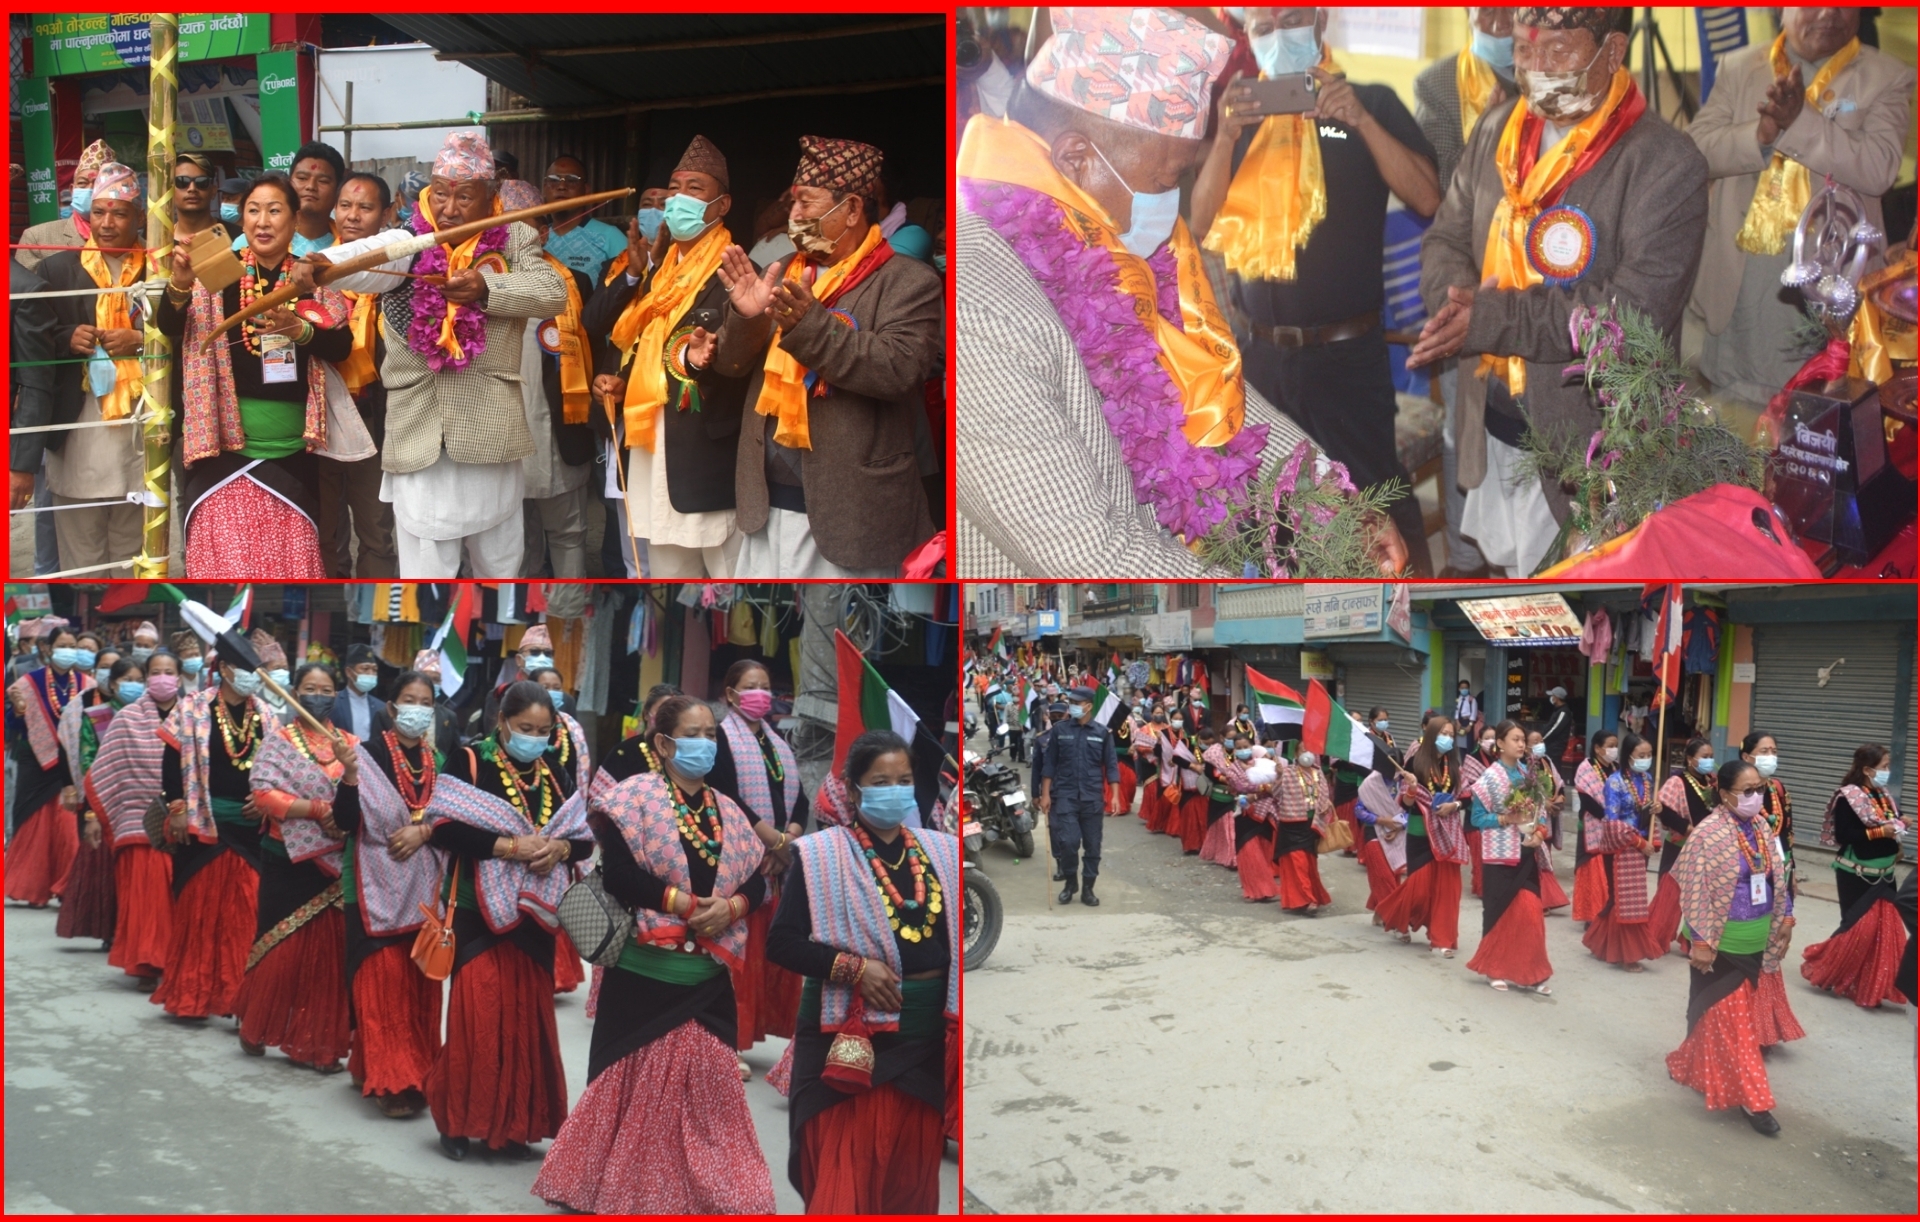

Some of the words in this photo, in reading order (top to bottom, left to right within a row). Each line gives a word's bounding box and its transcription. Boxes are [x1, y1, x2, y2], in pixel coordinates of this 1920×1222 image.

[50, 39, 62, 50] मा
[266, 77, 296, 90] TUBORG
[26, 102, 49, 114] TUBORG
[27, 180, 56, 192] TUBORG
